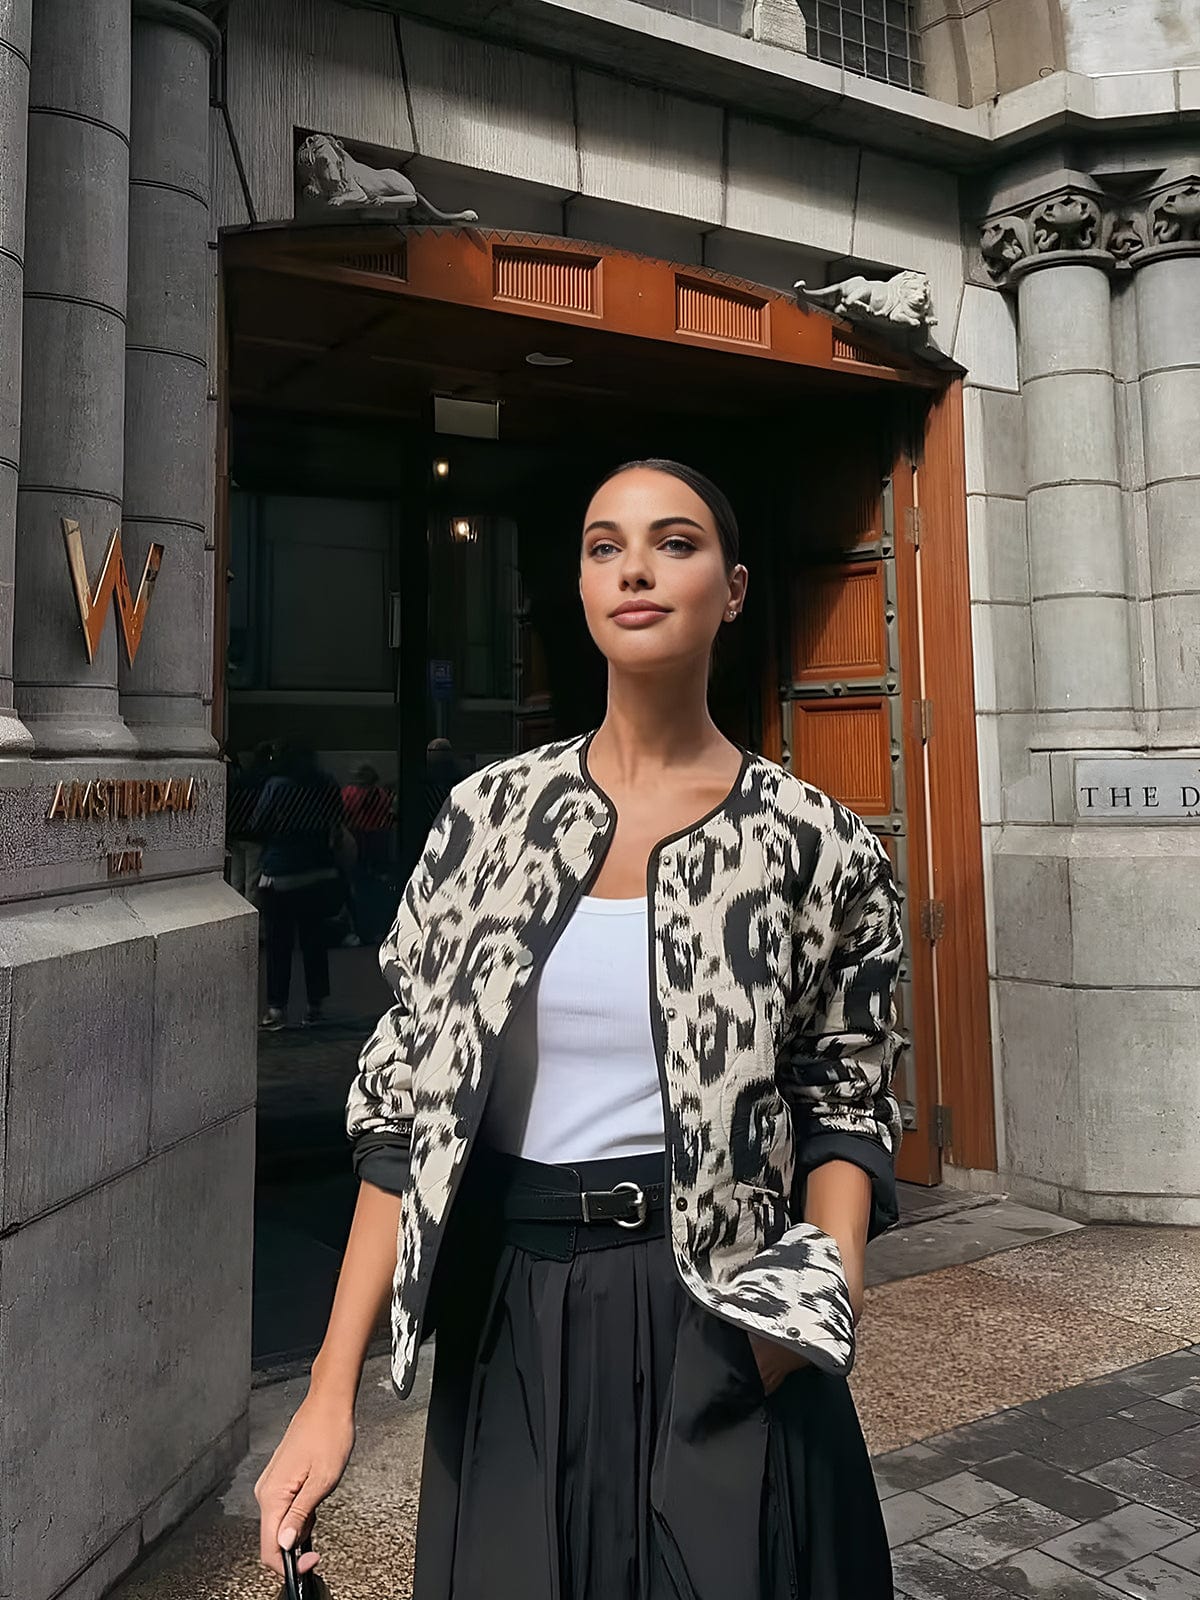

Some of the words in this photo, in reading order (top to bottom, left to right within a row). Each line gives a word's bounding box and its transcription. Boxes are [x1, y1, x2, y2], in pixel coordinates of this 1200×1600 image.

[62, 517, 164, 669] W
[1080, 787, 1160, 808] THE
[1180, 786, 1200, 808] D
